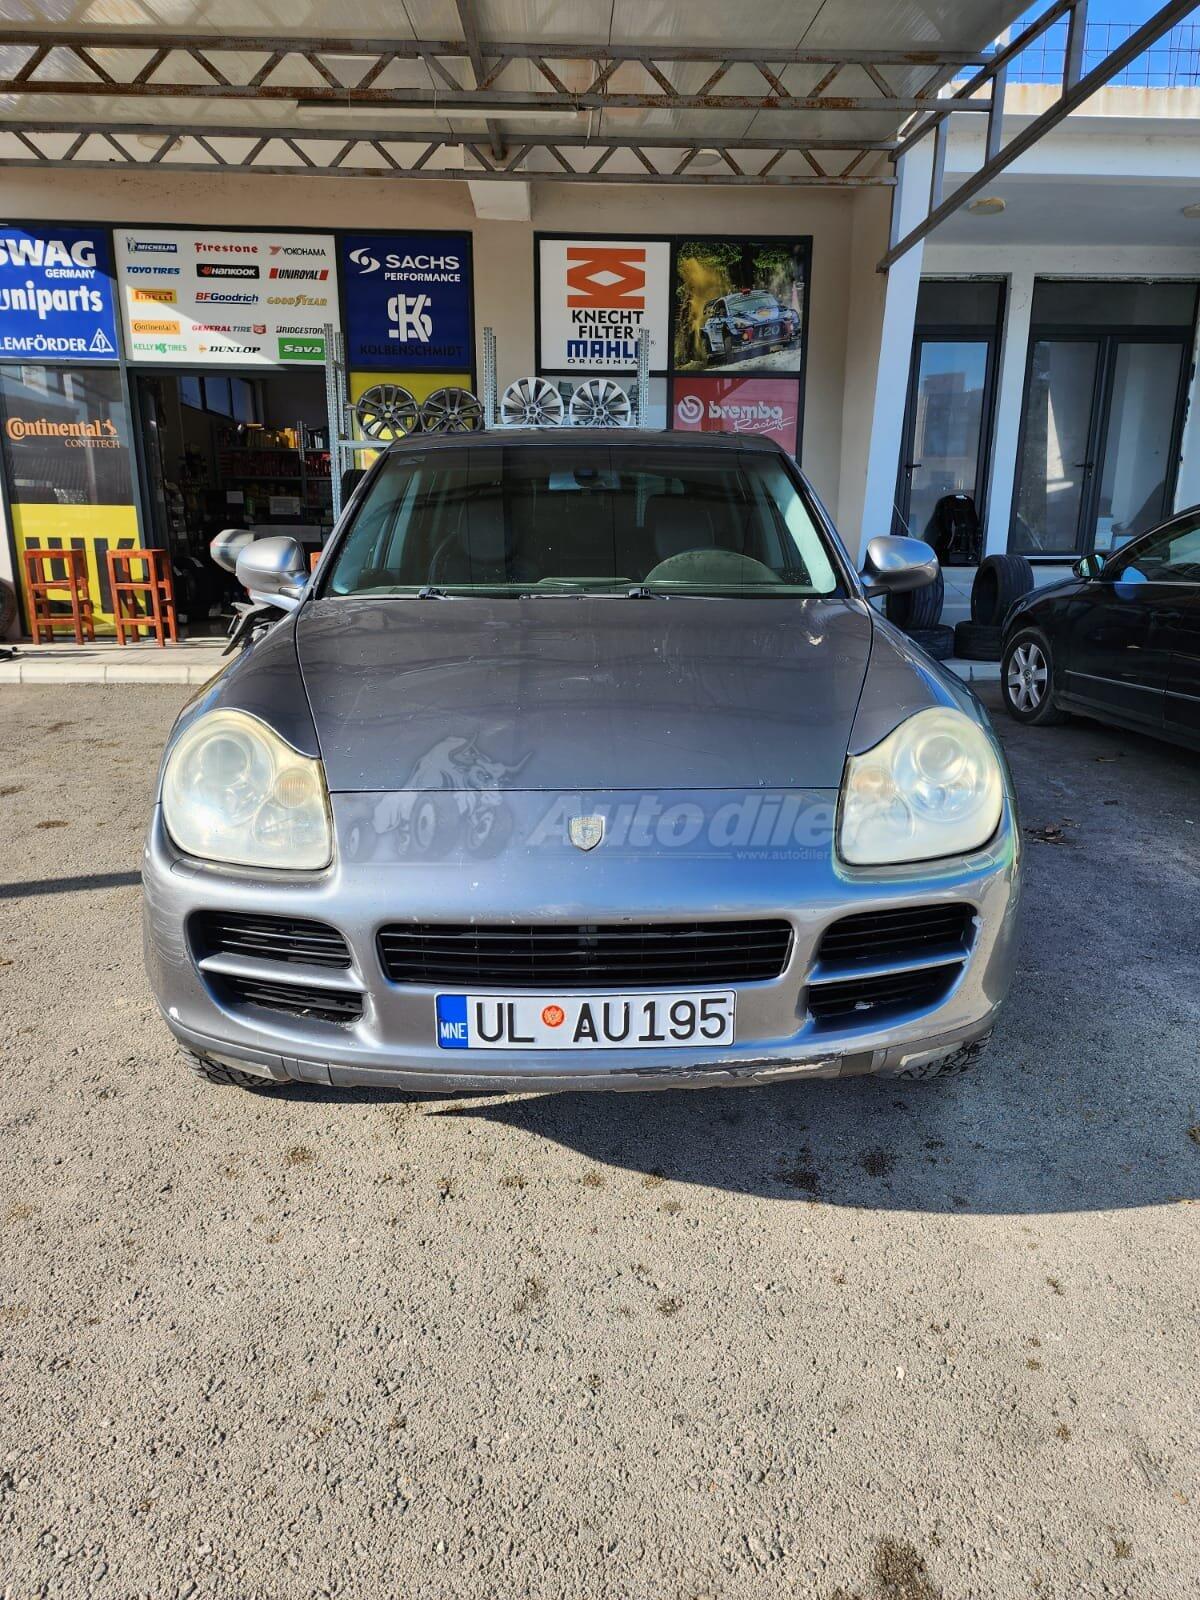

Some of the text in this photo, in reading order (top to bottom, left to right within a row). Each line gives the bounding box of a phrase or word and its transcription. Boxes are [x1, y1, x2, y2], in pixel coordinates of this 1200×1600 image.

[136, 243, 176, 252] MICHELIN
[194, 242, 259, 253] Firestone
[282, 247, 326, 256] YOKOHAMA
[385, 254, 460, 270] SACHS
[45, 268, 95, 279] GERMANY
[126, 266, 180, 275] TOYO TIRES
[278, 269, 319, 280] UNIROYAL
[385, 272, 461, 283] PERFORMANCE
[135, 290, 173, 301] PIRELLI
[195, 292, 259, 302] BFGoodrich
[572, 310, 644, 325] KNECHT
[133, 322, 171, 332] Continental
[232, 325, 252, 333] TIRE
[579, 326, 634, 339] FILTER
[134, 343, 153, 351] KELLY
[167, 344, 187, 352] TIRES
[209, 345, 261, 354] DUNLOP
[283, 344, 322, 353] Sava
[360, 343, 464, 357] KOLBENSCHMIDT
[709, 401, 784, 419] brembo
[6, 417, 102, 441] Continental
[64, 438, 121, 449] CONTITECH
[440, 997, 727, 1044] MNE UL AU195
